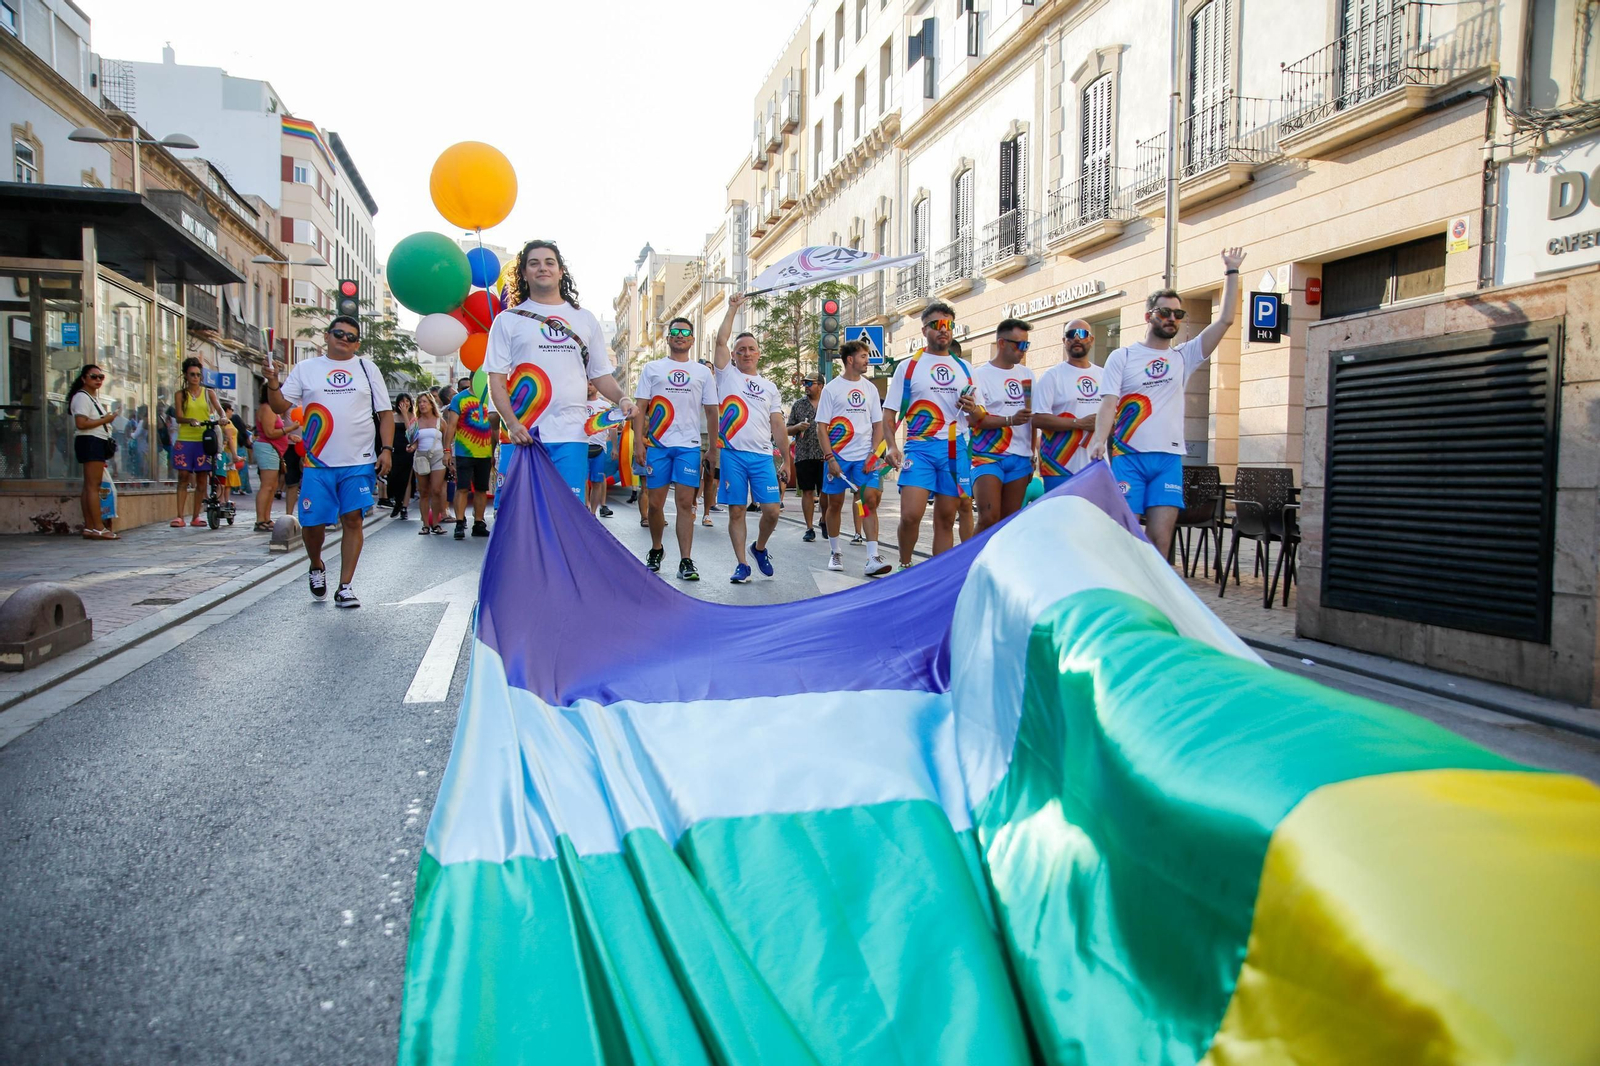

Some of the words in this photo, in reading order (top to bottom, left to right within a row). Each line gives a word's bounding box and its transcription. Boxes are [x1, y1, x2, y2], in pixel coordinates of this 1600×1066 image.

[1012, 302, 1028, 319] CAJA
[1029, 294, 1054, 314] RURAL
[1055, 280, 1097, 306] GRANADA
[1258, 301, 1274, 321] P
[222, 376, 230, 386] B
